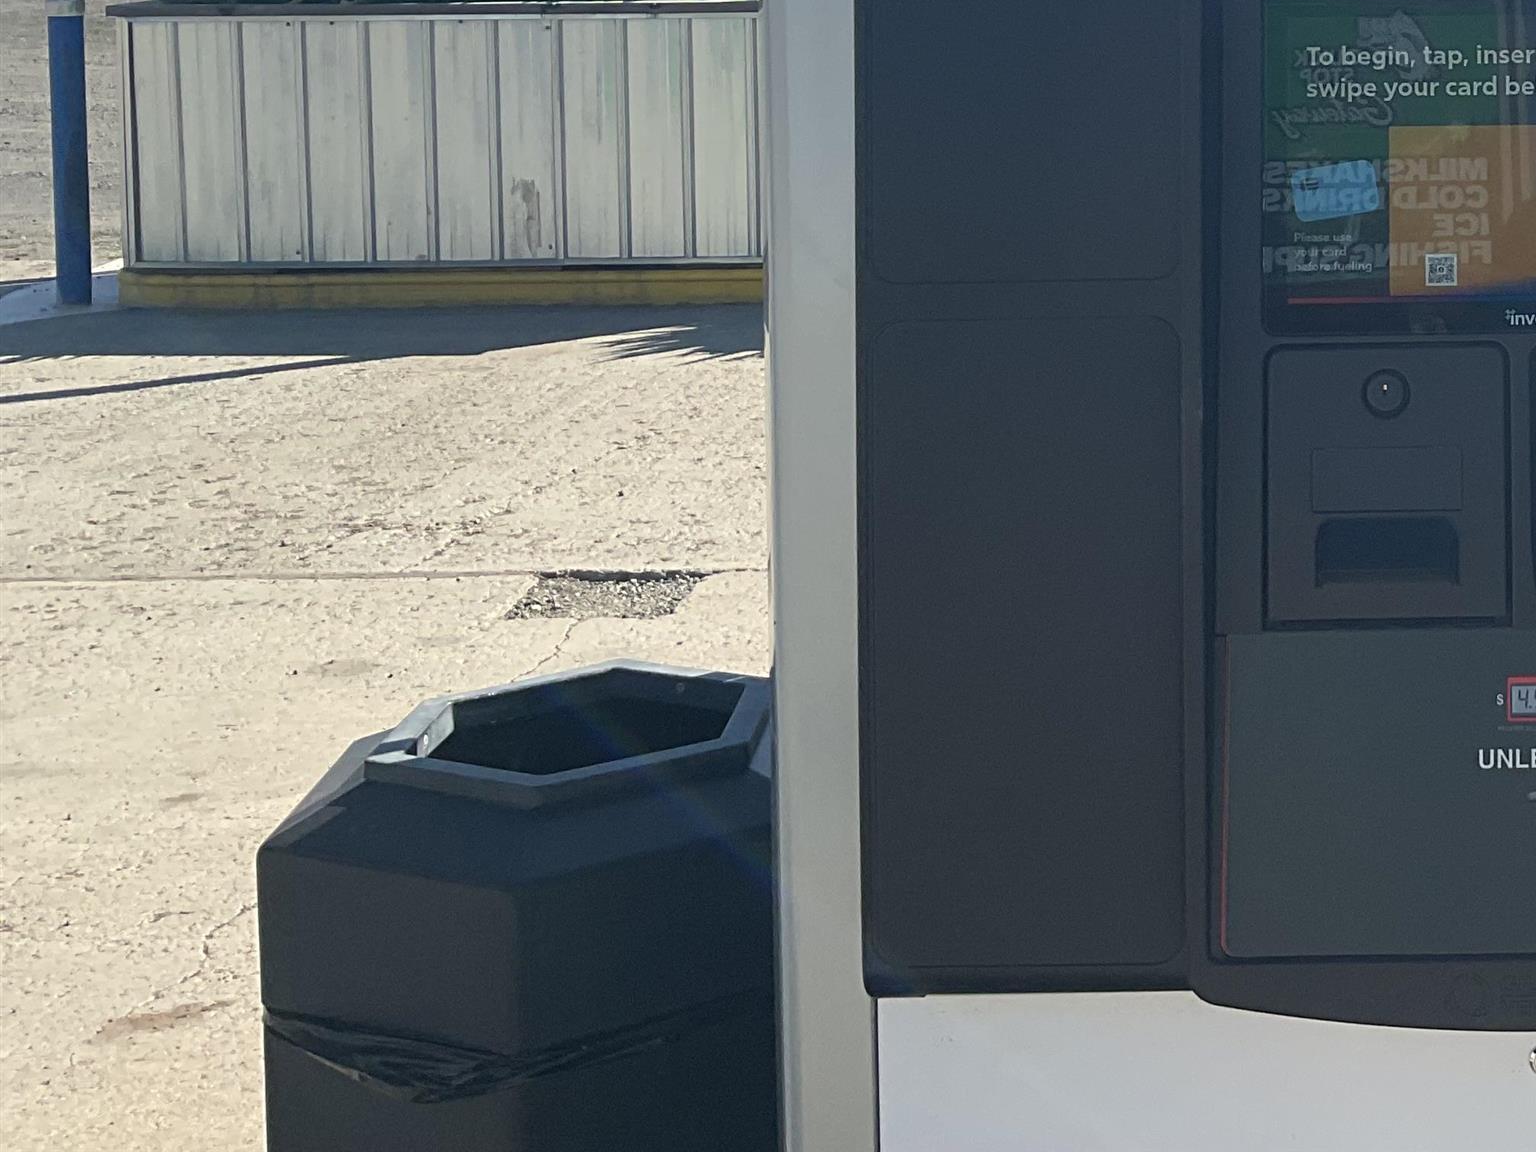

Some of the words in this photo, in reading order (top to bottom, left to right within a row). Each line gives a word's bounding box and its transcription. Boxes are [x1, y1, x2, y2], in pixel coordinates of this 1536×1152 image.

[1306, 46, 1334, 66] To
[1341, 45, 1416, 70] begin,
[1422, 45, 1469, 70] tap,
[1306, 77, 1377, 103] swipe
[1383, 81, 1440, 102] your
[1445, 75, 1497, 96] card
[1332, 234, 1353, 243] use
[1496, 693, 1505, 706] $
